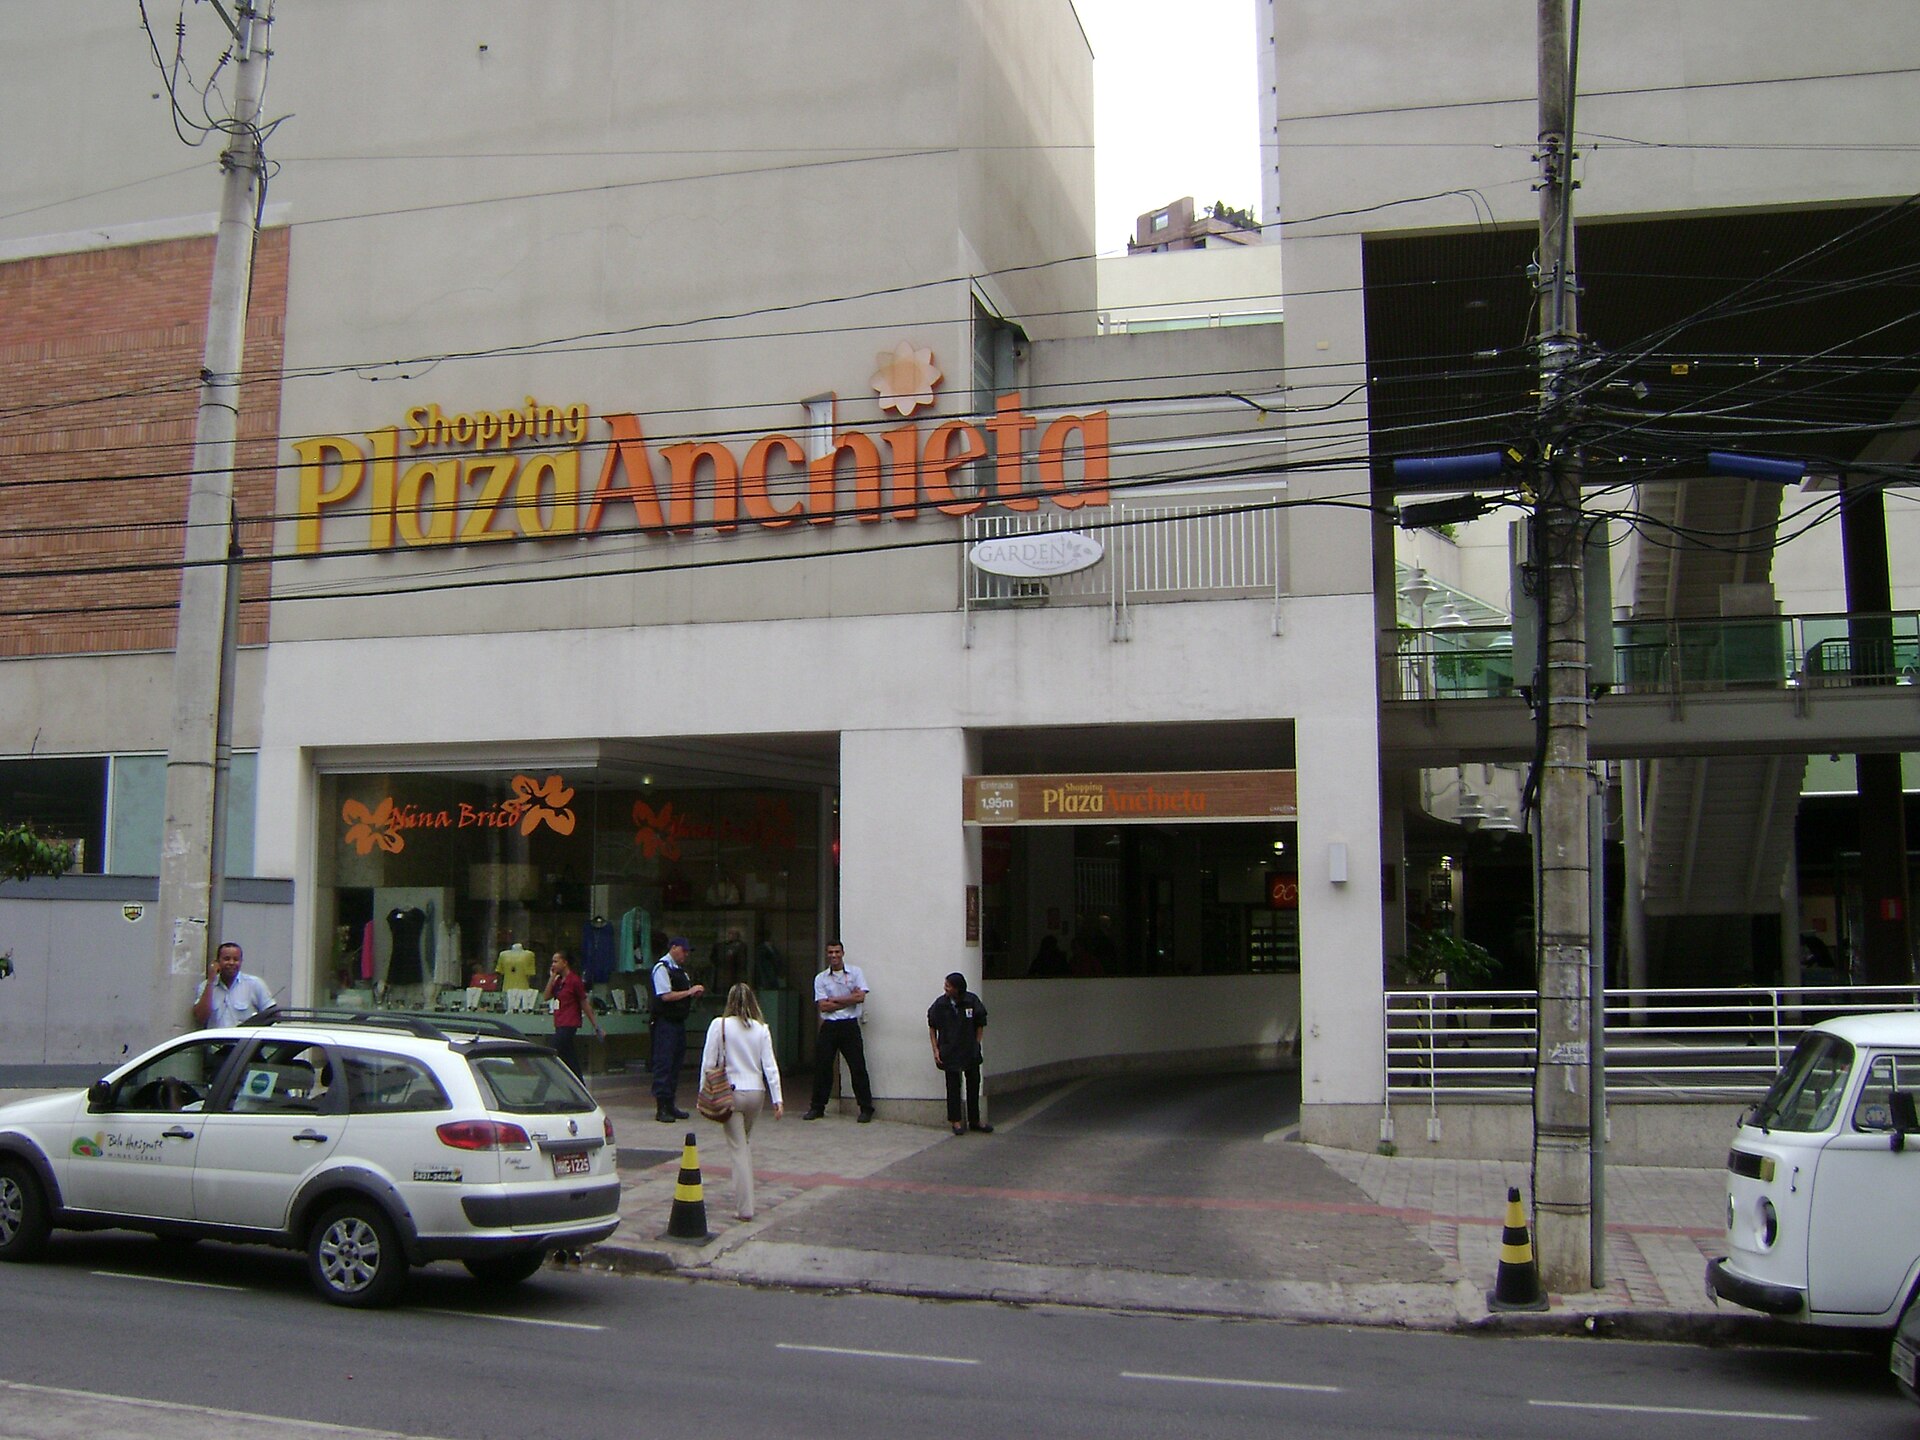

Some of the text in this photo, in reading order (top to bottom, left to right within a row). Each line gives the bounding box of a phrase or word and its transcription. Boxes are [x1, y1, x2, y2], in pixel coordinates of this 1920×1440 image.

[405, 396, 589, 450] Shopping
[292, 391, 1109, 556] Plaza Anchieta
[978, 543, 1065, 562] GARDEN
[1043, 786, 1206, 814] Plaza Anchieta
[1065, 782, 1103, 794] Shopping
[388, 804, 452, 830] Nina
